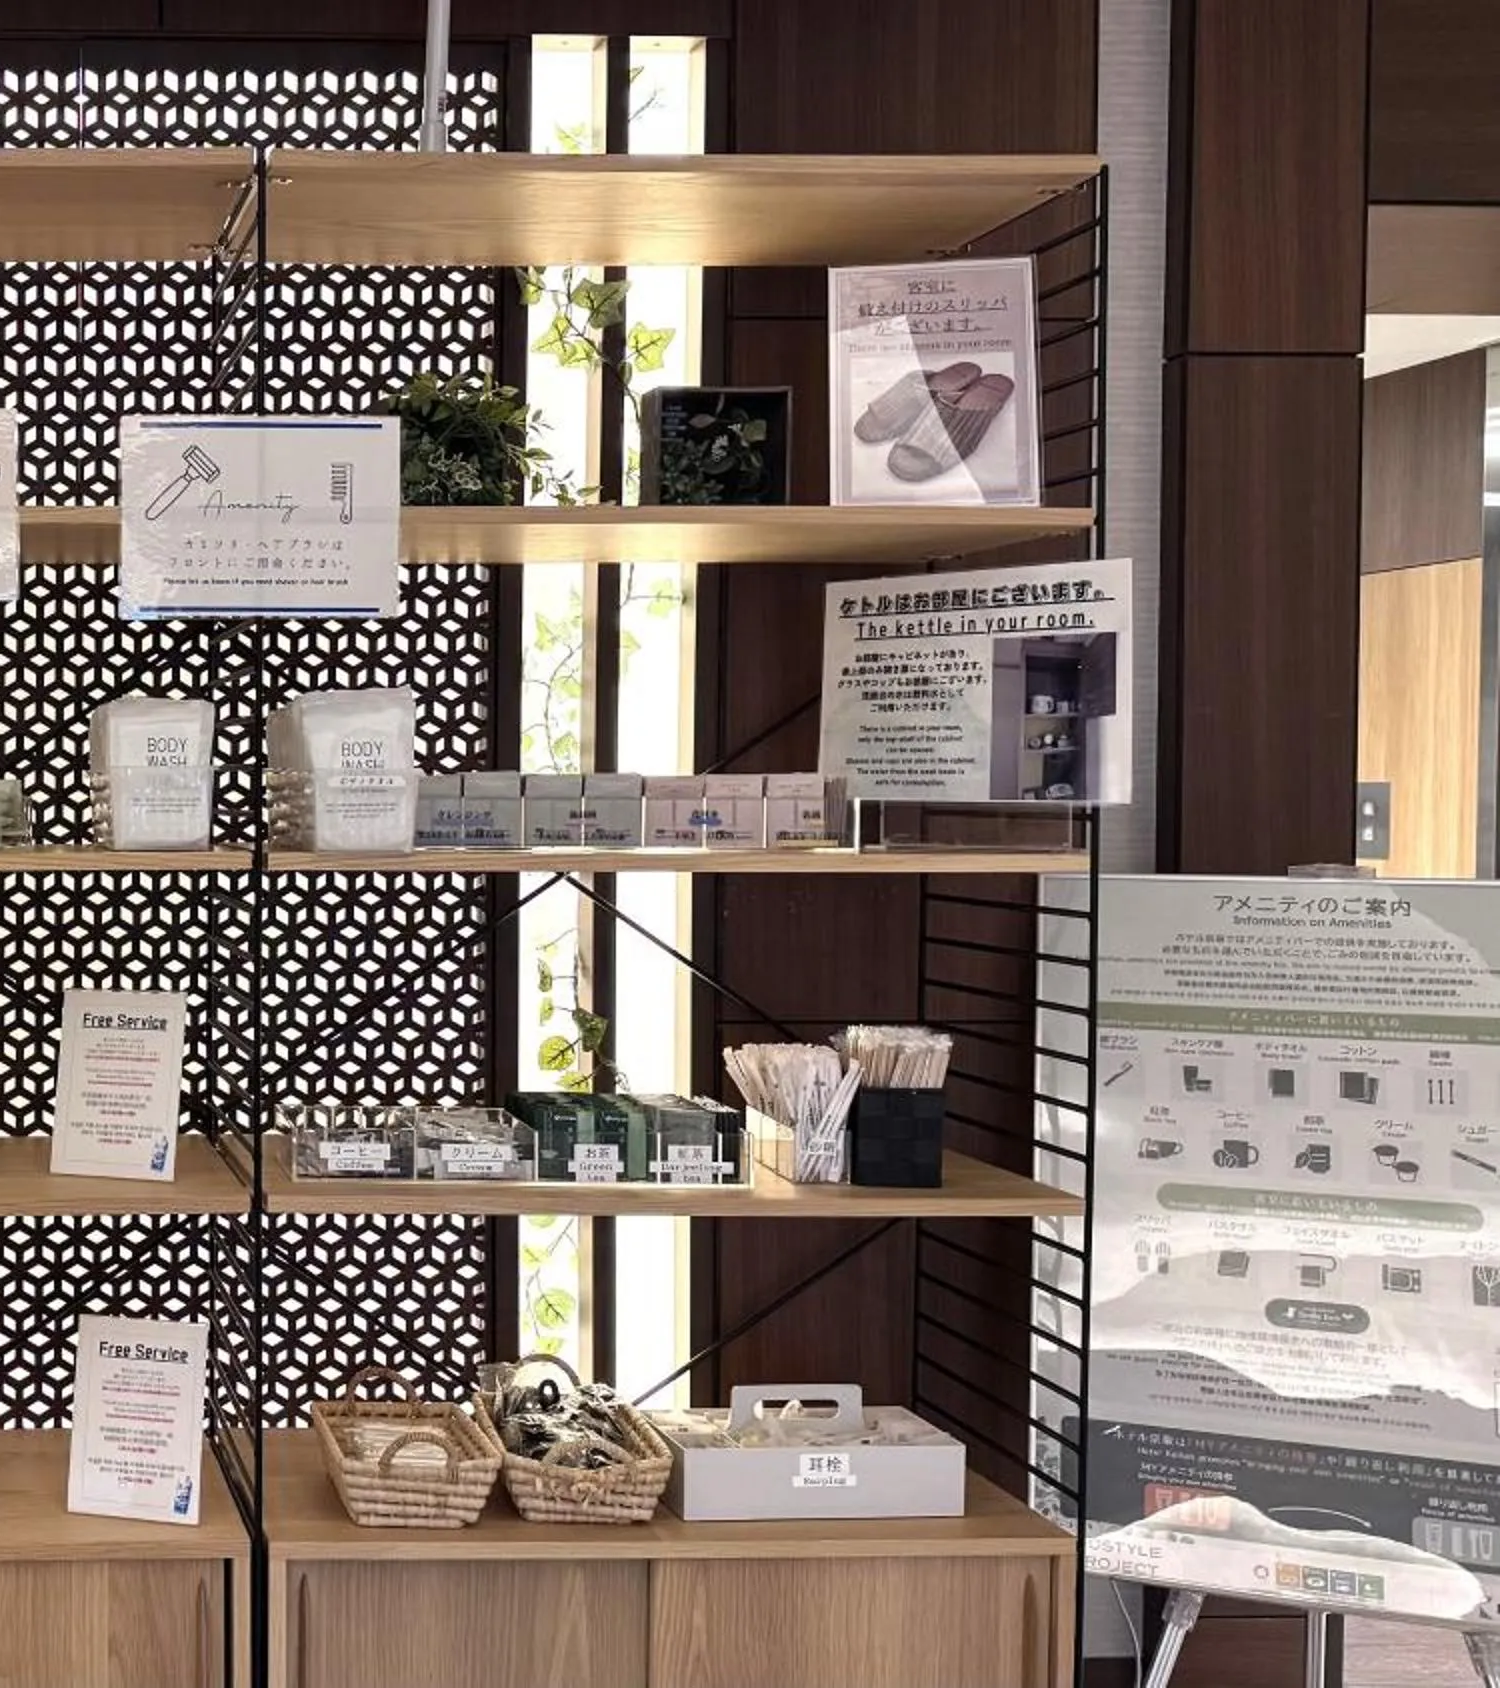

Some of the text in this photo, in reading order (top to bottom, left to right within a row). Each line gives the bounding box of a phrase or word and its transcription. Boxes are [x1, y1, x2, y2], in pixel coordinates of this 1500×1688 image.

[197, 488, 301, 525] Amenity
[839, 580, 1107, 615] ケトルはお部屋にございます。
[858, 610, 1095, 639] The kettle in your room.
[147, 737, 189, 752] BODY
[341, 741, 384, 757] BODY
[1212, 894, 1412, 918] アメニティのご案内
[1233, 914, 1393, 930] Information on Amenities
[82, 1012, 169, 1032] Free Service
[330, 1146, 383, 1157] コーヒー
[452, 1147, 504, 1159] クリーム
[585, 1147, 613, 1159] お茶
[579, 1161, 614, 1172] Green
[99, 1340, 190, 1363] Free Service
[808, 1455, 843, 1473] 耳栓
[1084, 1555, 1160, 1579] ROJECT
